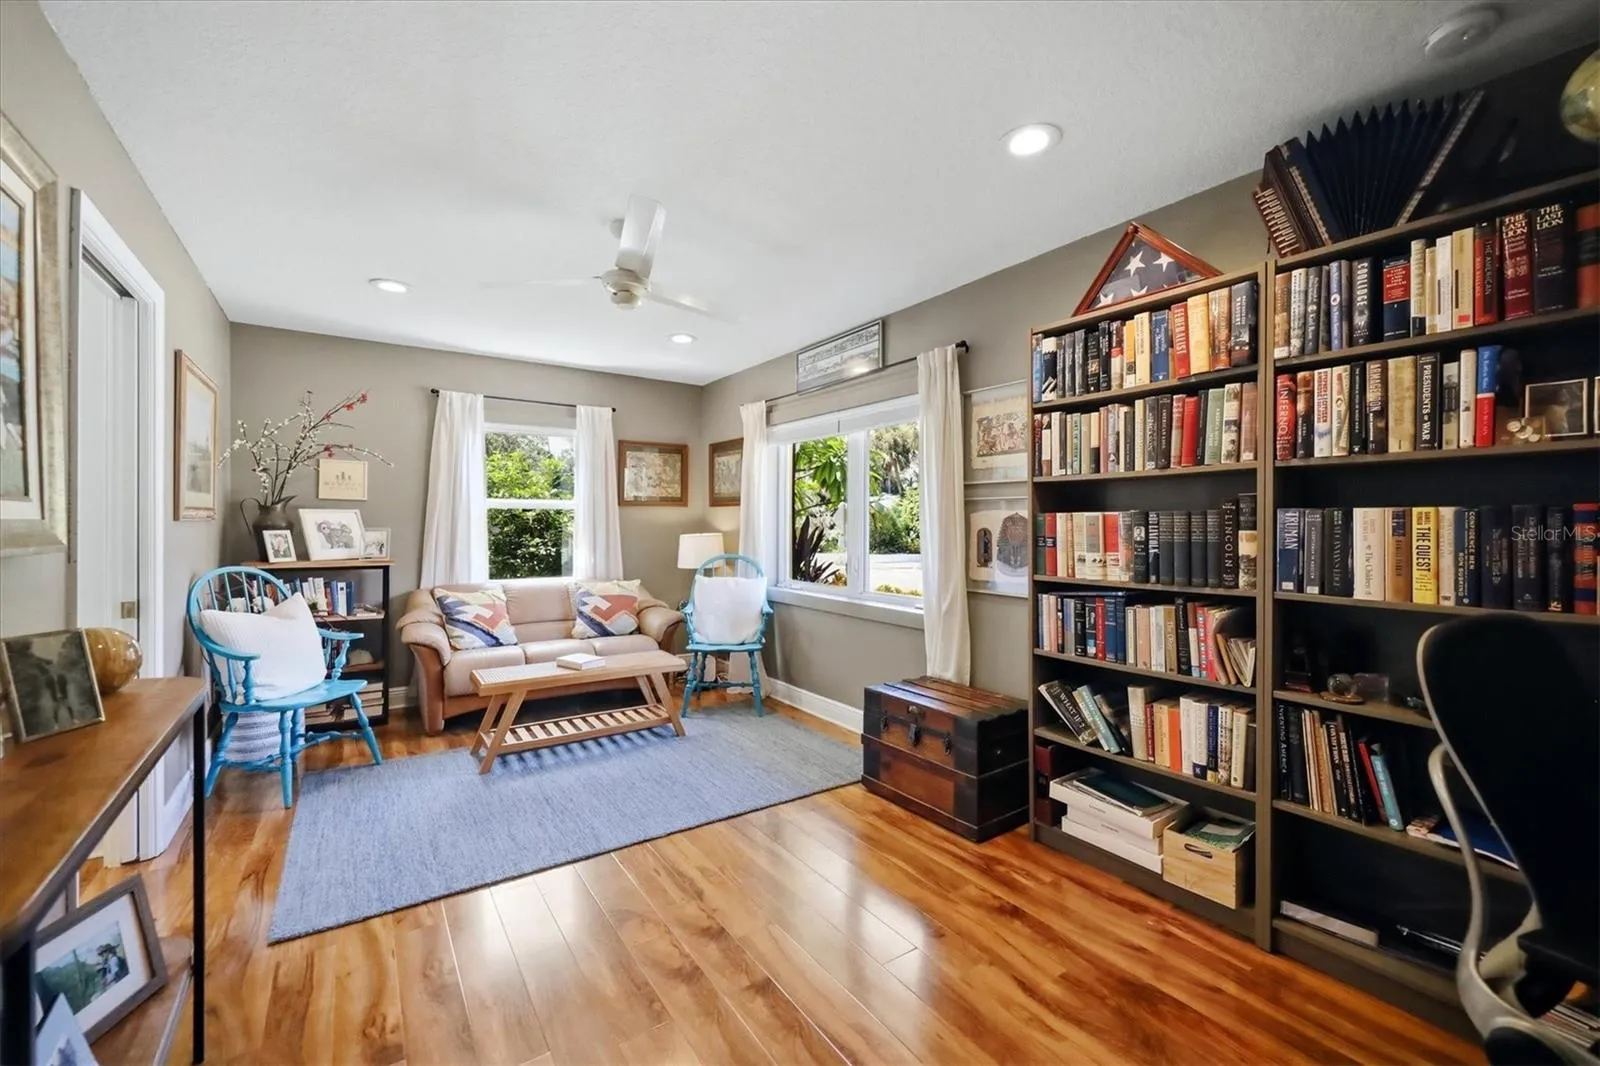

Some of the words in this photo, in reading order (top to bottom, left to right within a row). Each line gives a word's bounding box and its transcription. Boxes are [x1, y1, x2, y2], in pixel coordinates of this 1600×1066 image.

[1505, 213, 1525, 225] THE
[1536, 210, 1564, 224] LAST
[1540, 204, 1561, 215] THE
[1503, 220, 1527, 233] LAST
[1503, 227, 1527, 239] LION
[1536, 218, 1564, 231] LION
[1356, 262, 1369, 306] COOLIDGE
[1484, 256, 1492, 295] AMERICAN
[1174, 308, 1187, 355] FEDERALIST
[1422, 364, 1432, 414] PRESIDENTS
[1279, 387, 1289, 435] INFERNO
[1422, 421, 1431, 441] WAR
[1224, 515, 1234, 567] LINCOLN
[1284, 511, 1299, 550] TRUMAN
[1416, 527, 1431, 543] THE
[1468, 511, 1476, 552] CONFIDENCE
[1416, 544, 1431, 572] QUEST
[1457, 552, 1465, 566] RON
[1468, 555, 1476, 570] MEN
[1060, 693, 1075, 715] WHAT
[1280, 743, 1288, 773] AMERICA
